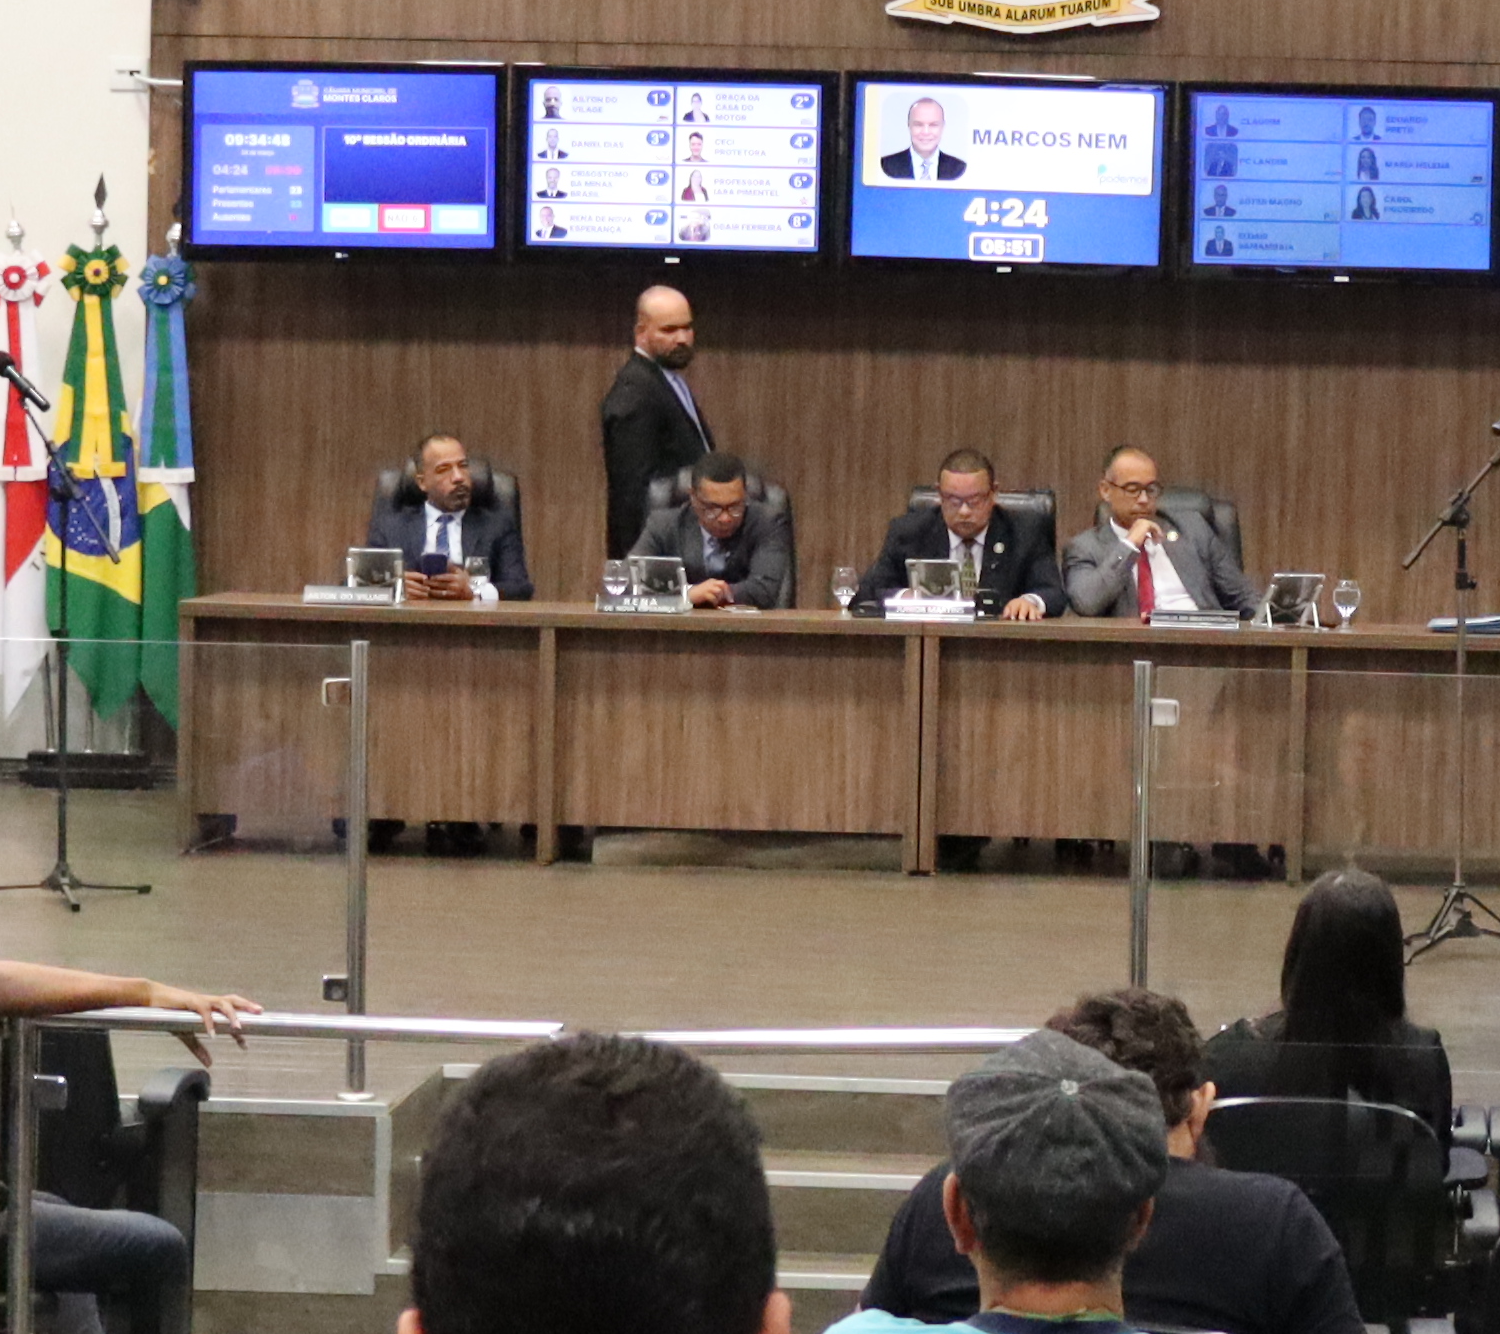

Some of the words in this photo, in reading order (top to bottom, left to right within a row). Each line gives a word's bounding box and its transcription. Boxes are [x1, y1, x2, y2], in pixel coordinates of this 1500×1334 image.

[957, 0, 1002, 19] UMBRA
[1005, 5, 1057, 22] ALARUM
[323, 94, 360, 103] MONTES
[362, 94, 398, 103] CLAROS
[605, 96, 618, 104] DO
[741, 104, 754, 112] DO
[363, 131, 405, 146] SESSÃO
[407, 132, 467, 147] ORDINÁRIA
[972, 129, 1072, 148] MARCOS
[1077, 132, 1128, 150] NEM
[571, 140, 601, 148] DANIEL
[212, 163, 249, 176] 04:24
[713, 178, 771, 187] PROFESSORA
[736, 189, 780, 197] PIMENTEL
[963, 196, 1050, 228] 4:24
[569, 225, 622, 234] ESPERANÇA
[980, 238, 1033, 257] 05:51
[623, 597, 658, 606] RENA
